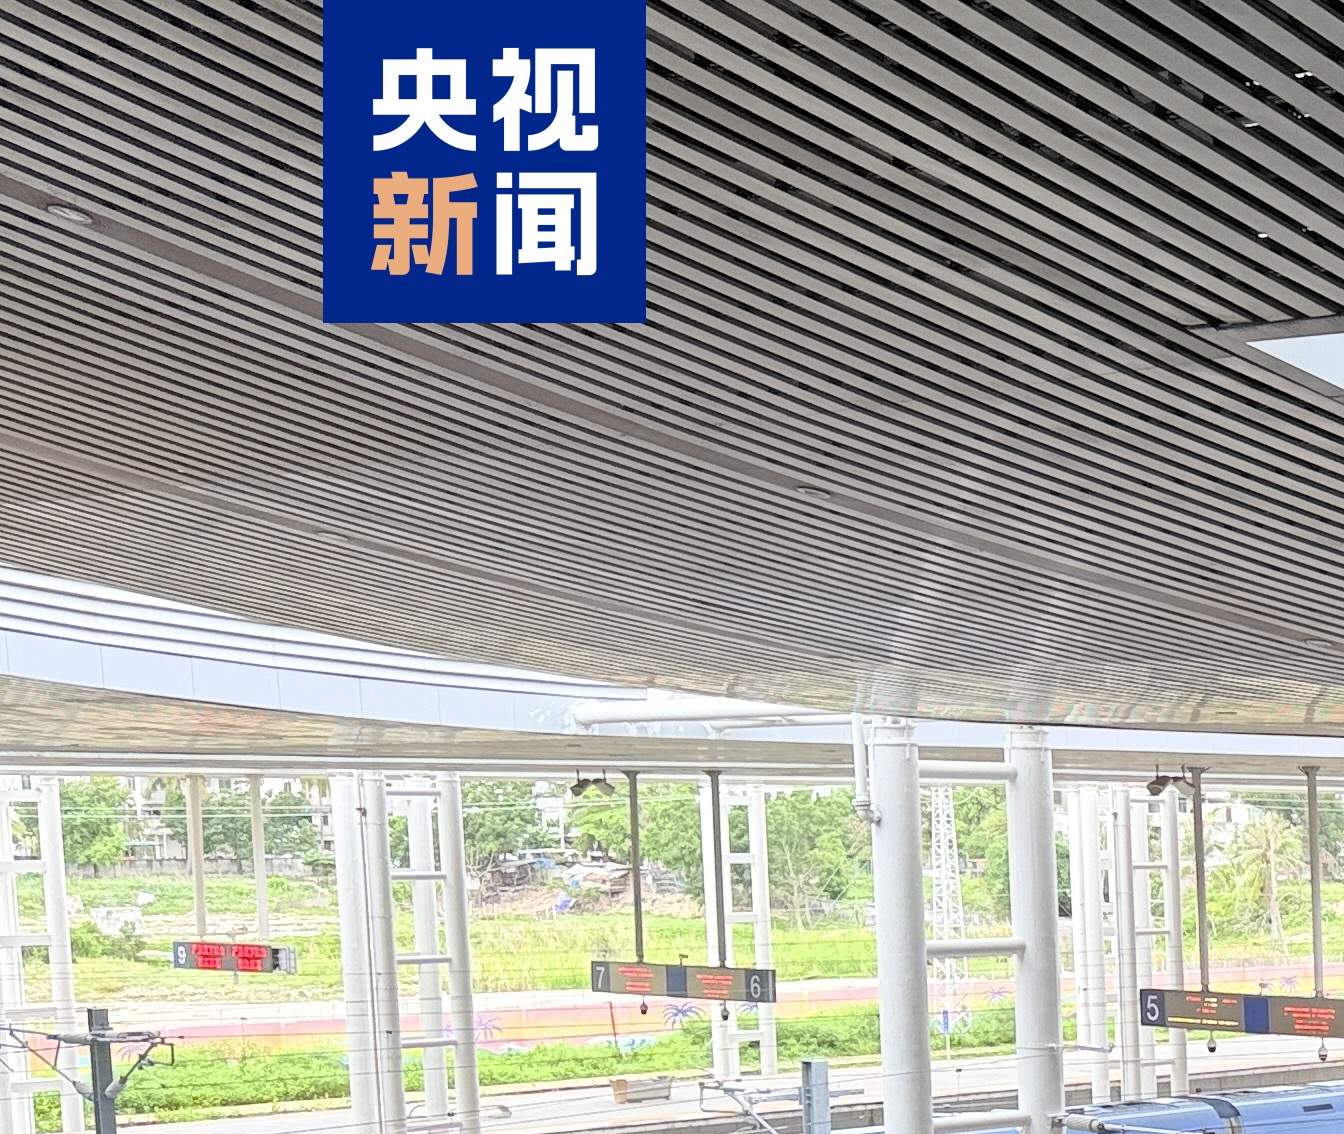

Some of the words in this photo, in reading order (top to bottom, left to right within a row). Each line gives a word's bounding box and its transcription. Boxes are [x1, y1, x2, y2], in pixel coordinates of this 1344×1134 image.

[177, 945, 187, 965] 9
[595, 966, 605, 990] 7
[750, 975, 761, 999] 6
[1146, 995, 1159, 1022] 5
